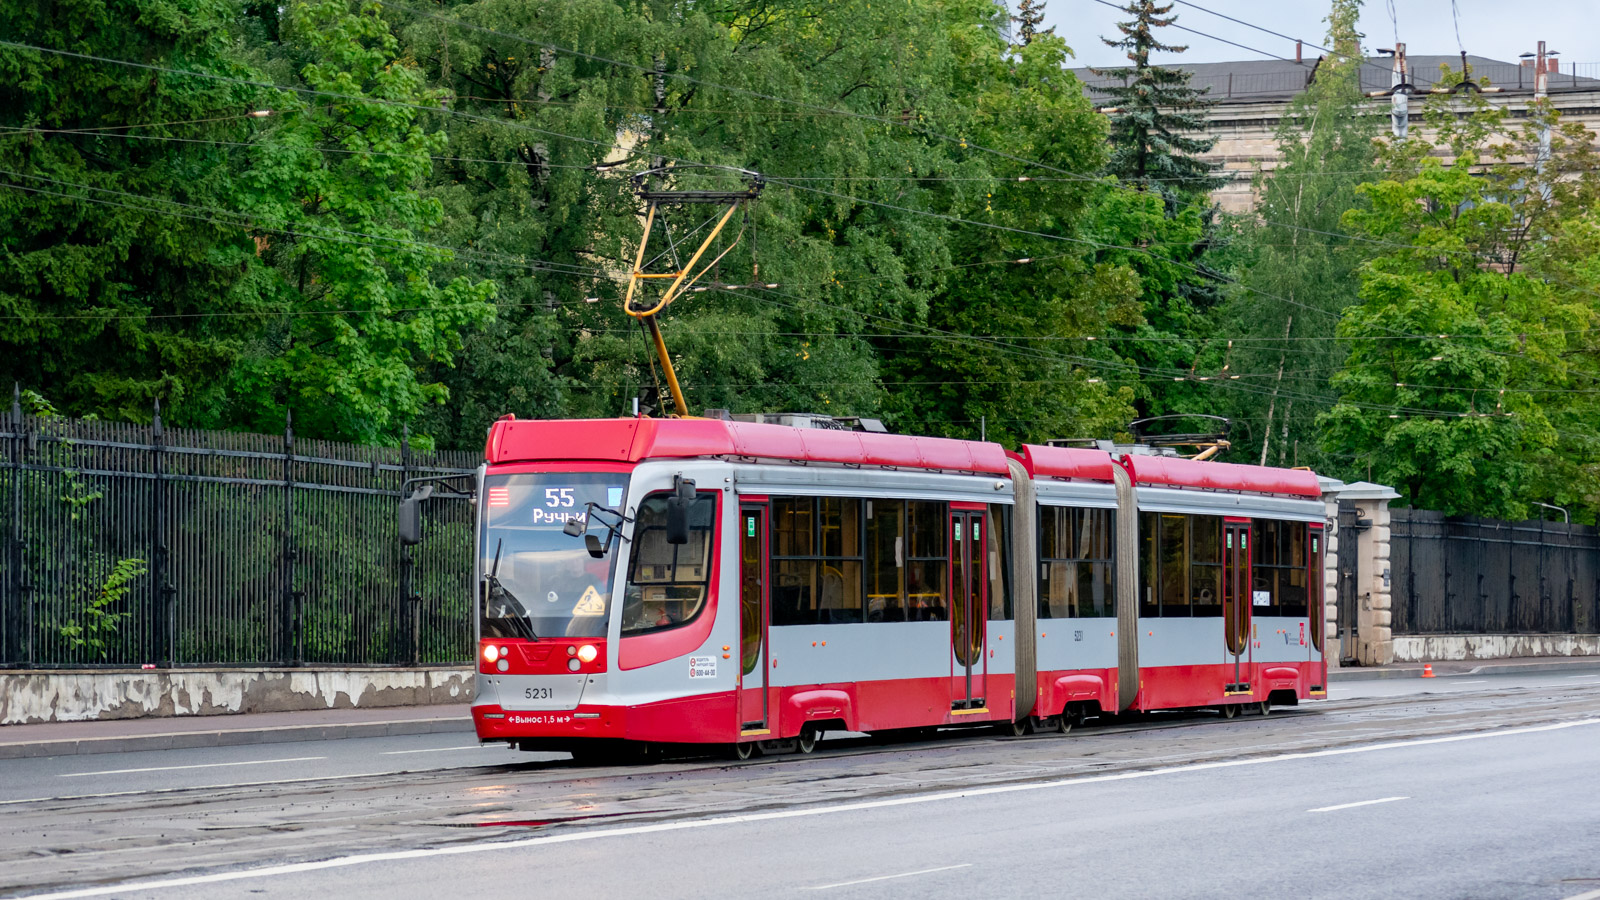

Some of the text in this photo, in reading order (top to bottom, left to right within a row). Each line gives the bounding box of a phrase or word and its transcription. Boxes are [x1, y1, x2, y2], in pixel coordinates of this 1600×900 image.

[545, 488, 575, 508] 55
[525, 688, 553, 699] 5231
[515, 715, 542, 724] Вынос
[543, 715, 555, 724] 1,5
